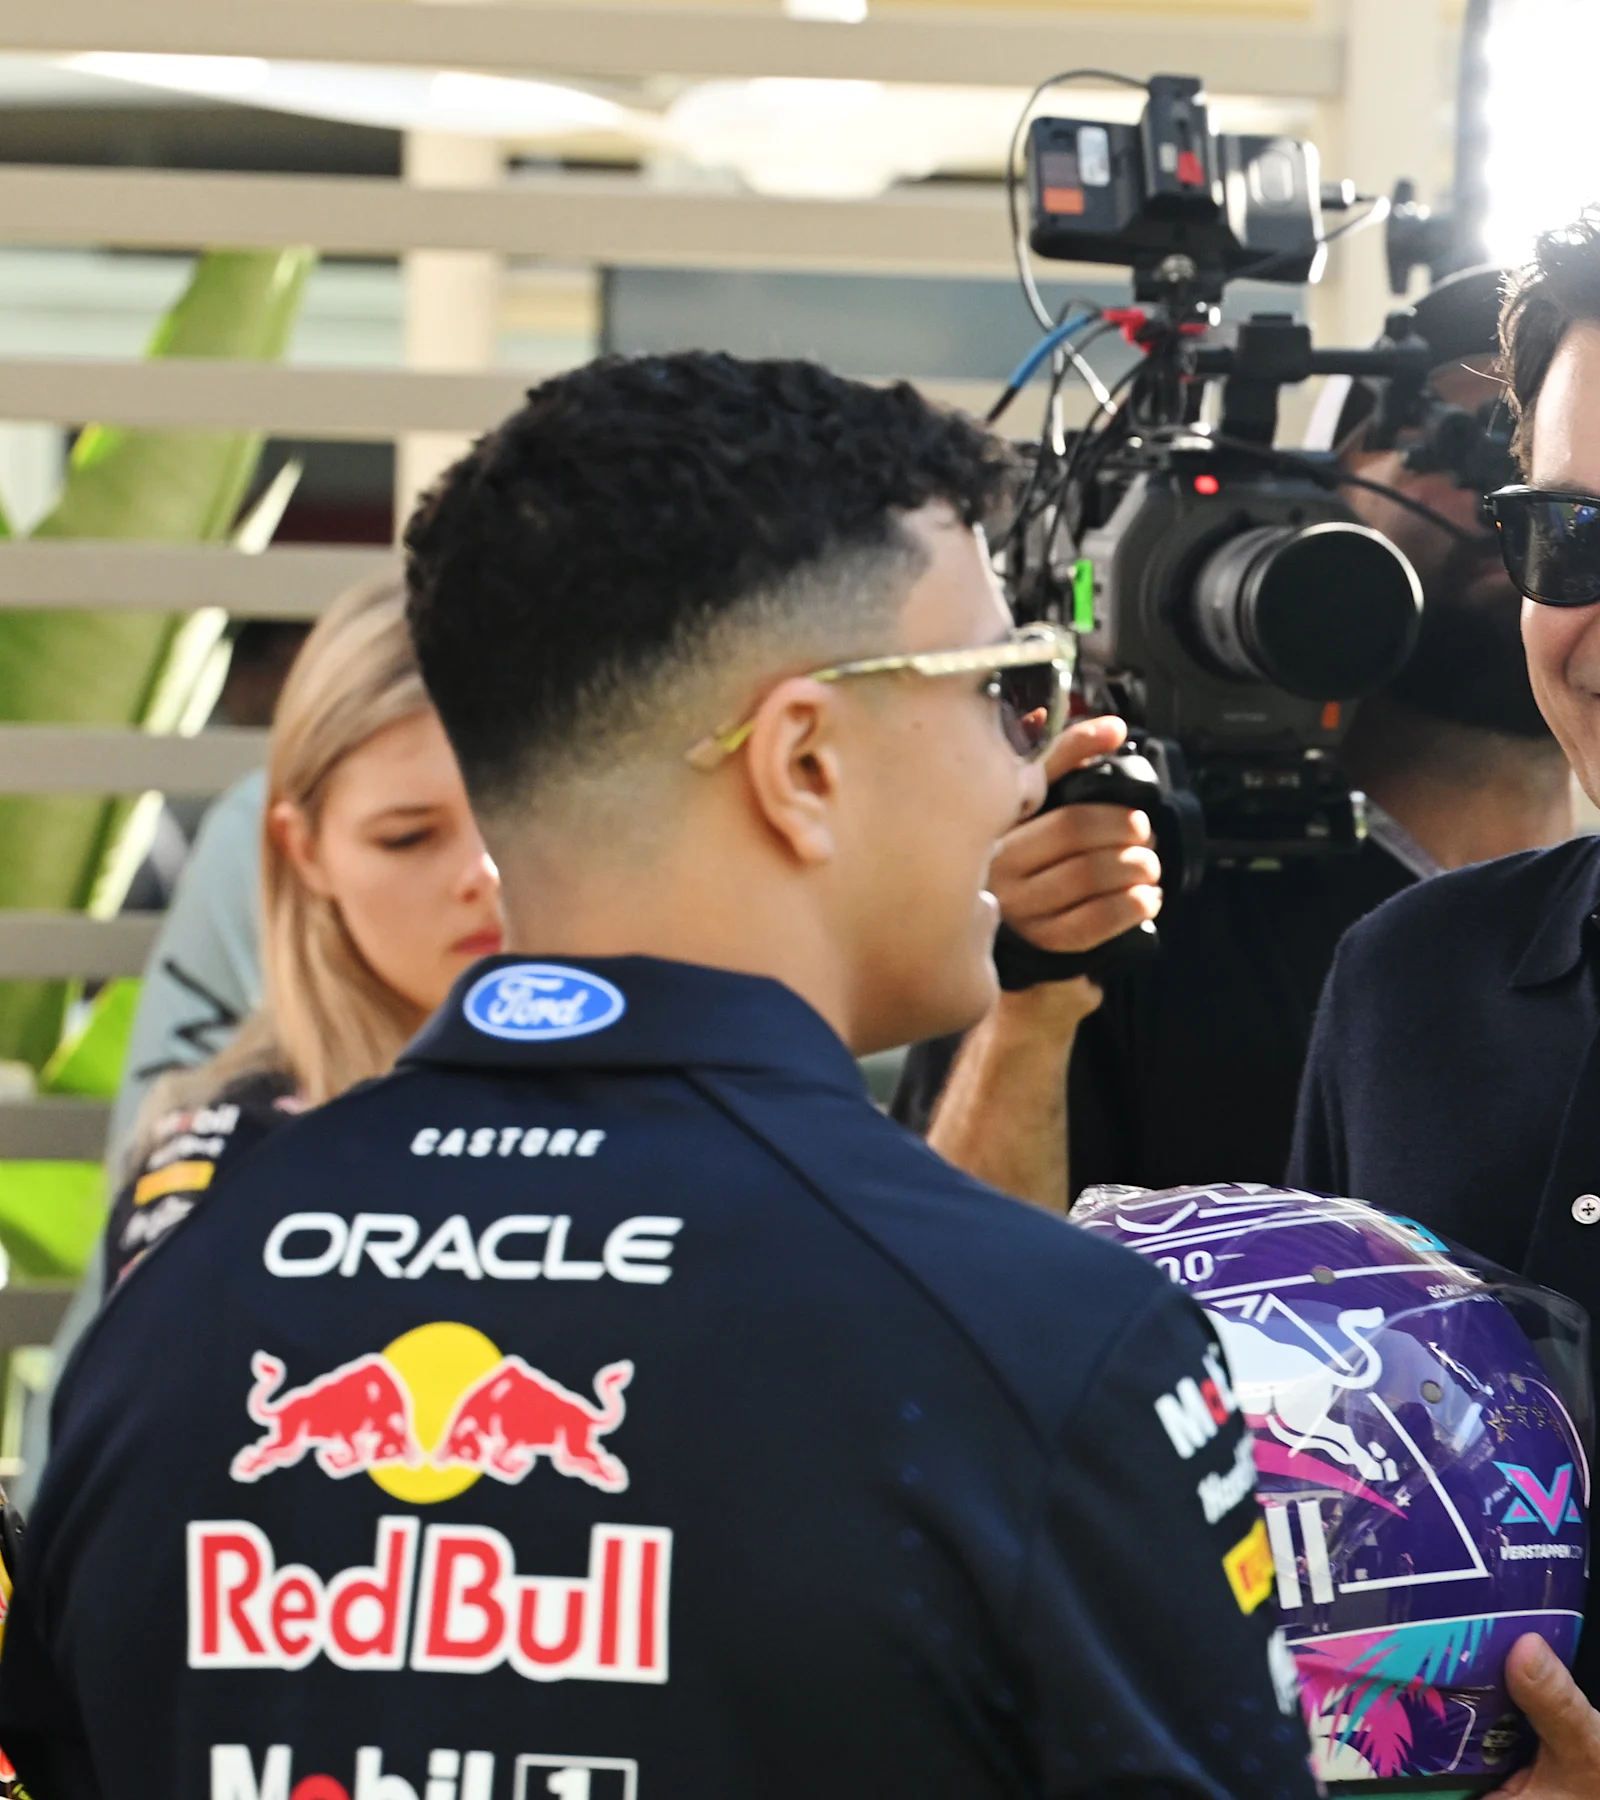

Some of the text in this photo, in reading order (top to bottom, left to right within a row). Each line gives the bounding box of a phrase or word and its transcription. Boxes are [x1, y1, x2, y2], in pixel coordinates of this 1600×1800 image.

[488, 974, 589, 1026] Ford
[410, 1127, 606, 1157] CASTORE
[262, 1211, 684, 1285] ORACLE
